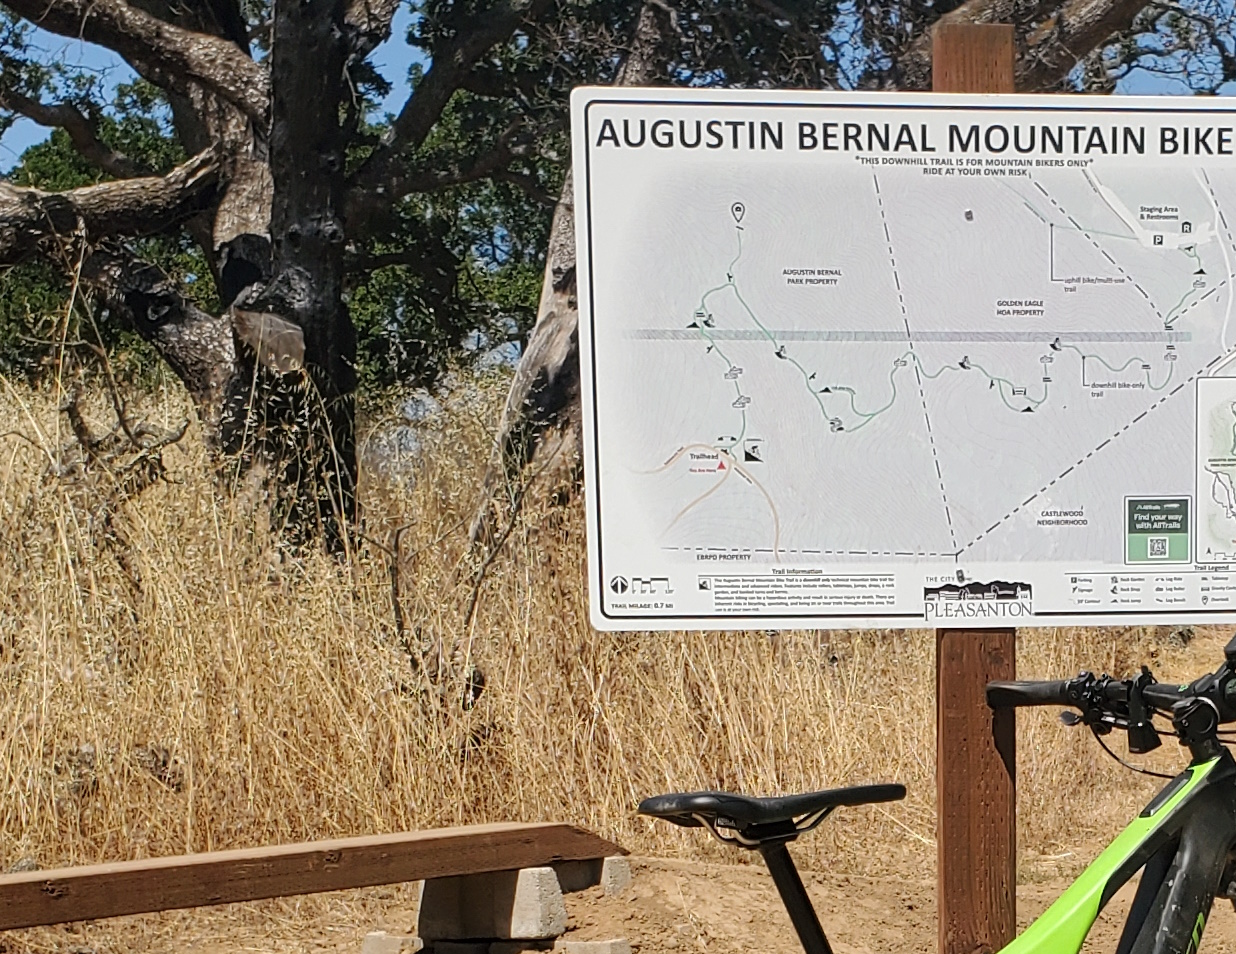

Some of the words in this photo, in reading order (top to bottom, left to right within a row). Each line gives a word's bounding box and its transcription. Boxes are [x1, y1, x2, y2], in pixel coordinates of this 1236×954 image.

[595, 118, 783, 150] AUGUSTIN
[798, 122, 936, 152] BERNAL
[948, 124, 1145, 154] MOUNTAIN
[1159, 127, 1233, 155] BIKE
[881, 156, 928, 166] DOWNHILL
[929, 157, 954, 166] TRAIL
[955, 157, 964, 166] IS
[965, 157, 983, 167] FOR
[984, 158, 1033, 167] MOUNTAIN
[1034, 159, 1065, 167] BIKERS
[922, 167, 943, 176] RIDE
[944, 167, 956, 176] AT
[956, 167, 982, 176] YOUR
[983, 167, 1006, 176] OWN
[1007, 168, 1027, 176] RISK
[1091, 381, 1117, 389] downhill
[1134, 513, 1150, 521] Find
[1151, 514, 1167, 522] your
[1167, 514, 1183, 522] way
[925, 602, 1032, 621] PLEASANTON
